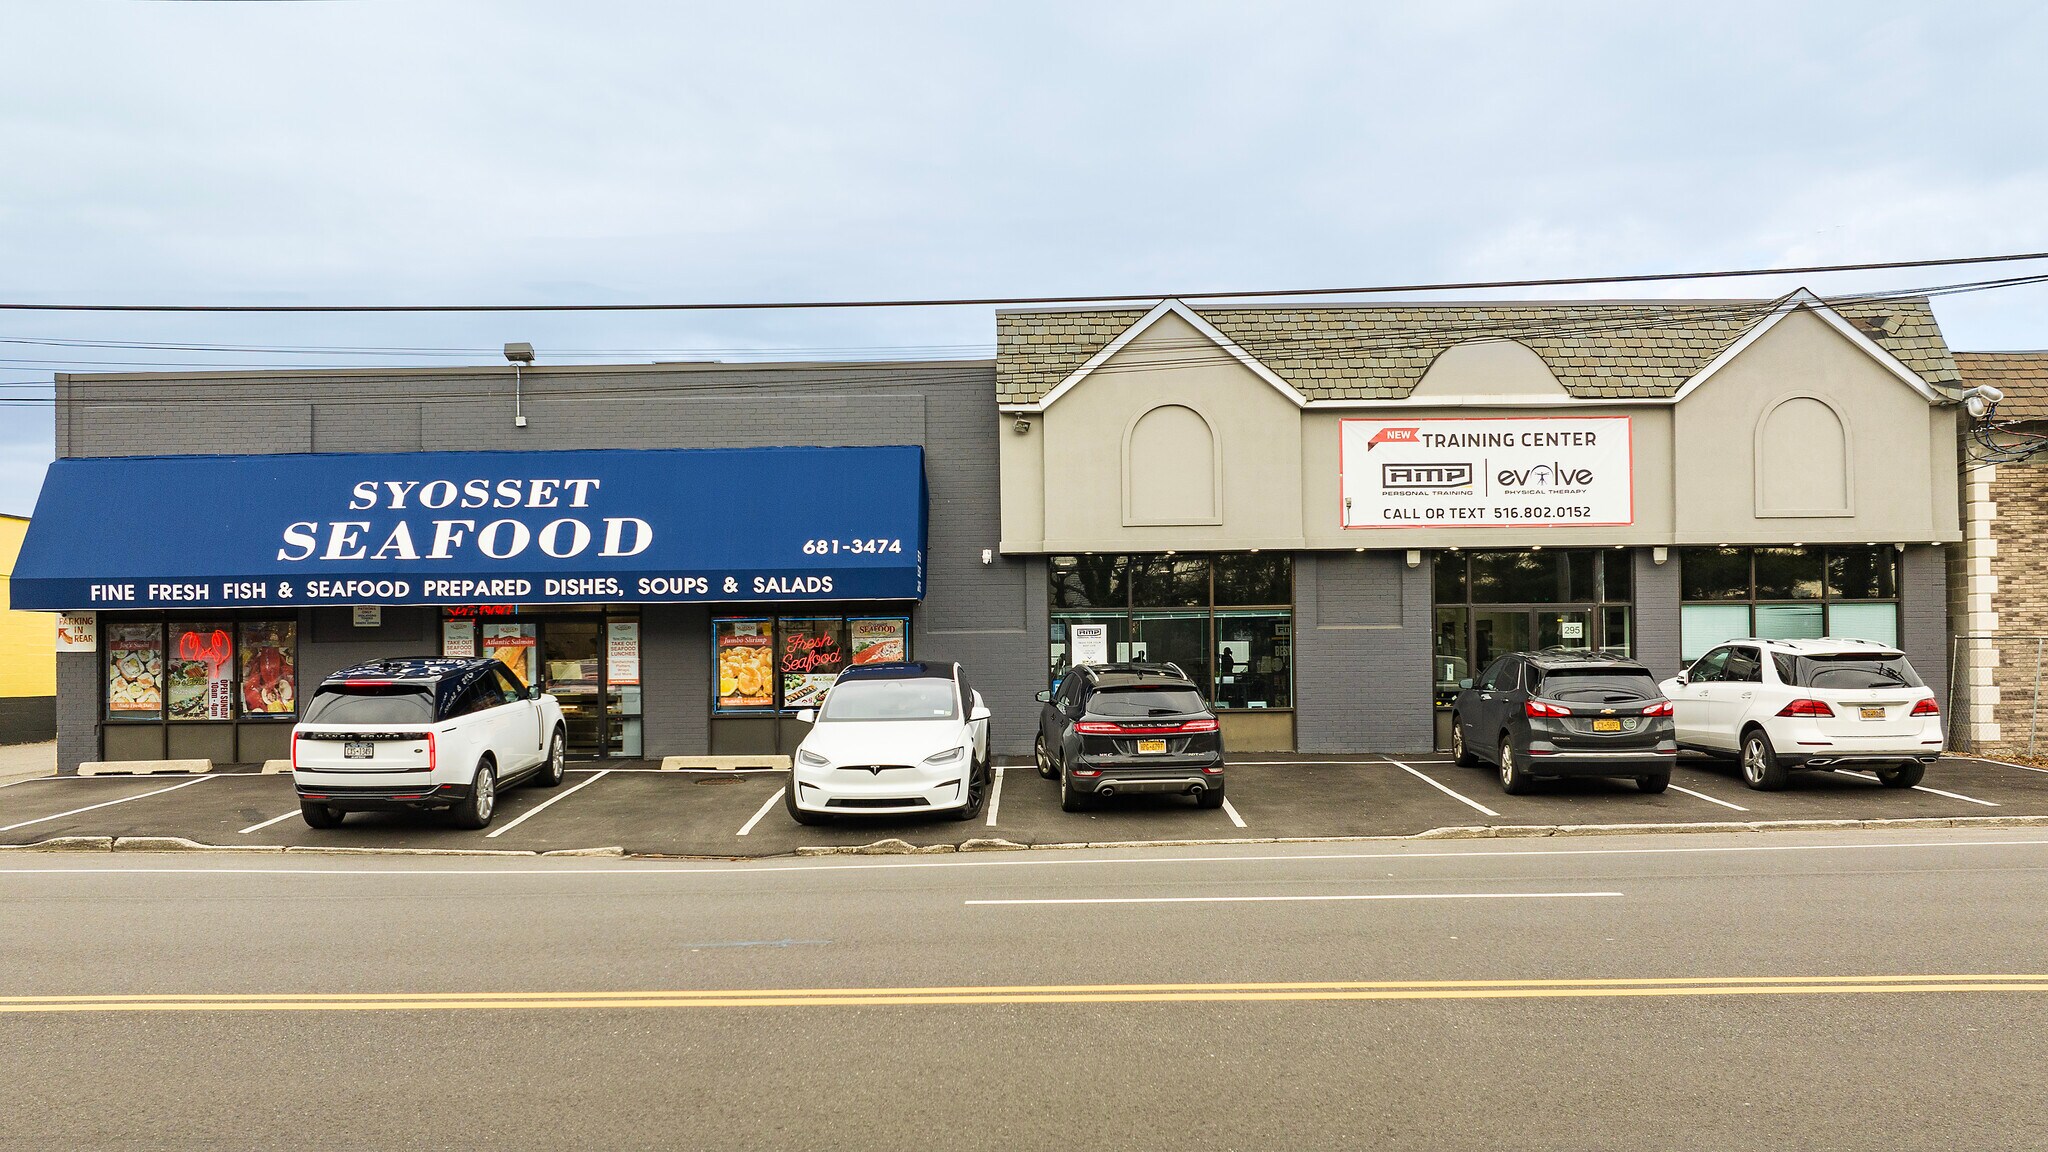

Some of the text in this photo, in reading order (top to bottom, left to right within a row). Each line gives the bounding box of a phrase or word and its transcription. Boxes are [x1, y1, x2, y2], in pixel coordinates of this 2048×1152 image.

[1387, 430, 1411, 439] NEW
[1423, 432, 1596, 448] TRAINING CENTER
[1388, 468, 1467, 483] AMP
[1497, 462, 1593, 486] evolve
[349, 479, 600, 510] SYOSSET
[1383, 506, 1591, 519] CALL OR TEXT 516.802.0152
[277, 518, 652, 561] SEAFOOD
[803, 539, 902, 555] 681-3474
[90, 575, 833, 601] FINE FRESH FISH & SEAFOOD PREPARED DISHES, SOUPS & SALADS
[59, 617, 94, 625] PARKING
[74, 626, 83, 634] IN
[859, 625, 896, 634] SEAFOOD
[1564, 626, 1580, 635] 295
[74, 635, 93, 643] REAR
[744, 636, 768, 645] Shrimp
[786, 631, 834, 653] Fresh
[781, 647, 842, 674] Seafood
[211, 682, 219, 698] 10am
[220, 679, 228, 718] OPEN SUNDAY
[211, 703, 219, 717] 4pm
